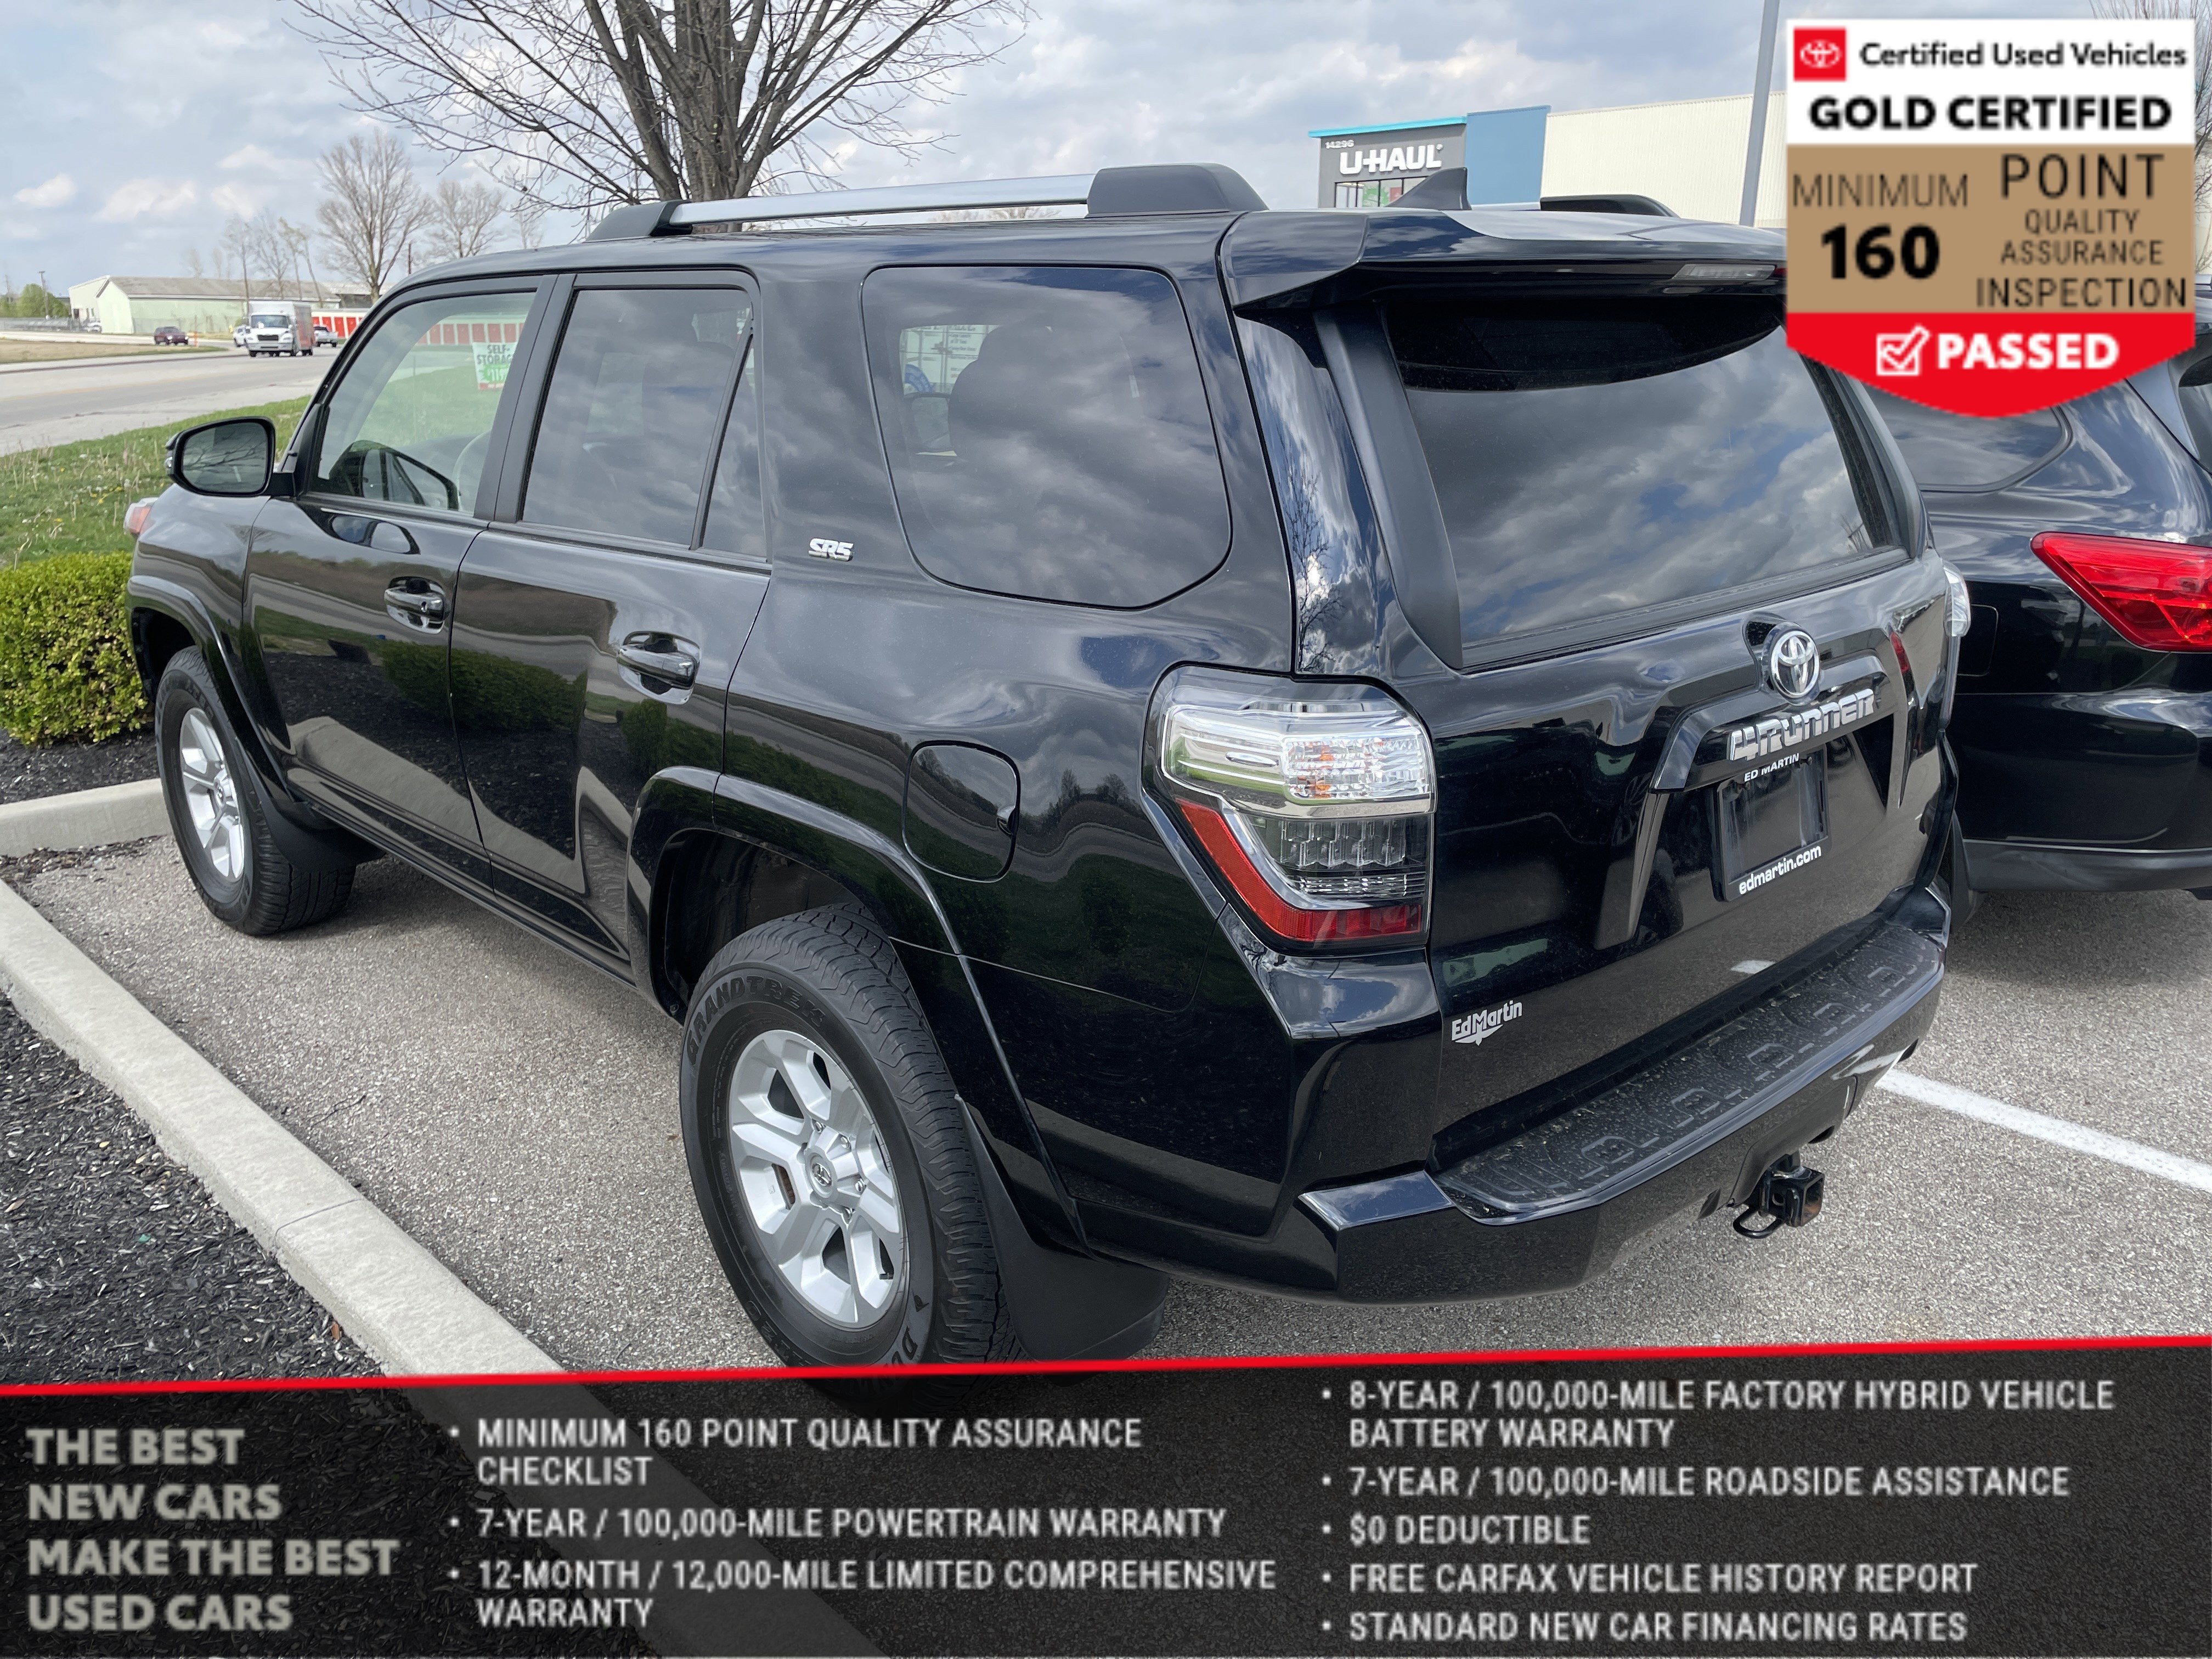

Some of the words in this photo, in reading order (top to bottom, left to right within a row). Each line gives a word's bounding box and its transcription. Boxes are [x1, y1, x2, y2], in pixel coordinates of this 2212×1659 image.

[1339, 144, 1442, 174] U-HAUL
[808, 538, 854, 561] SR5
[1744, 769, 1759, 782] ED
[1761, 753, 1799, 775] MARTIN
[1739, 845, 1821, 895] edmartin.com
